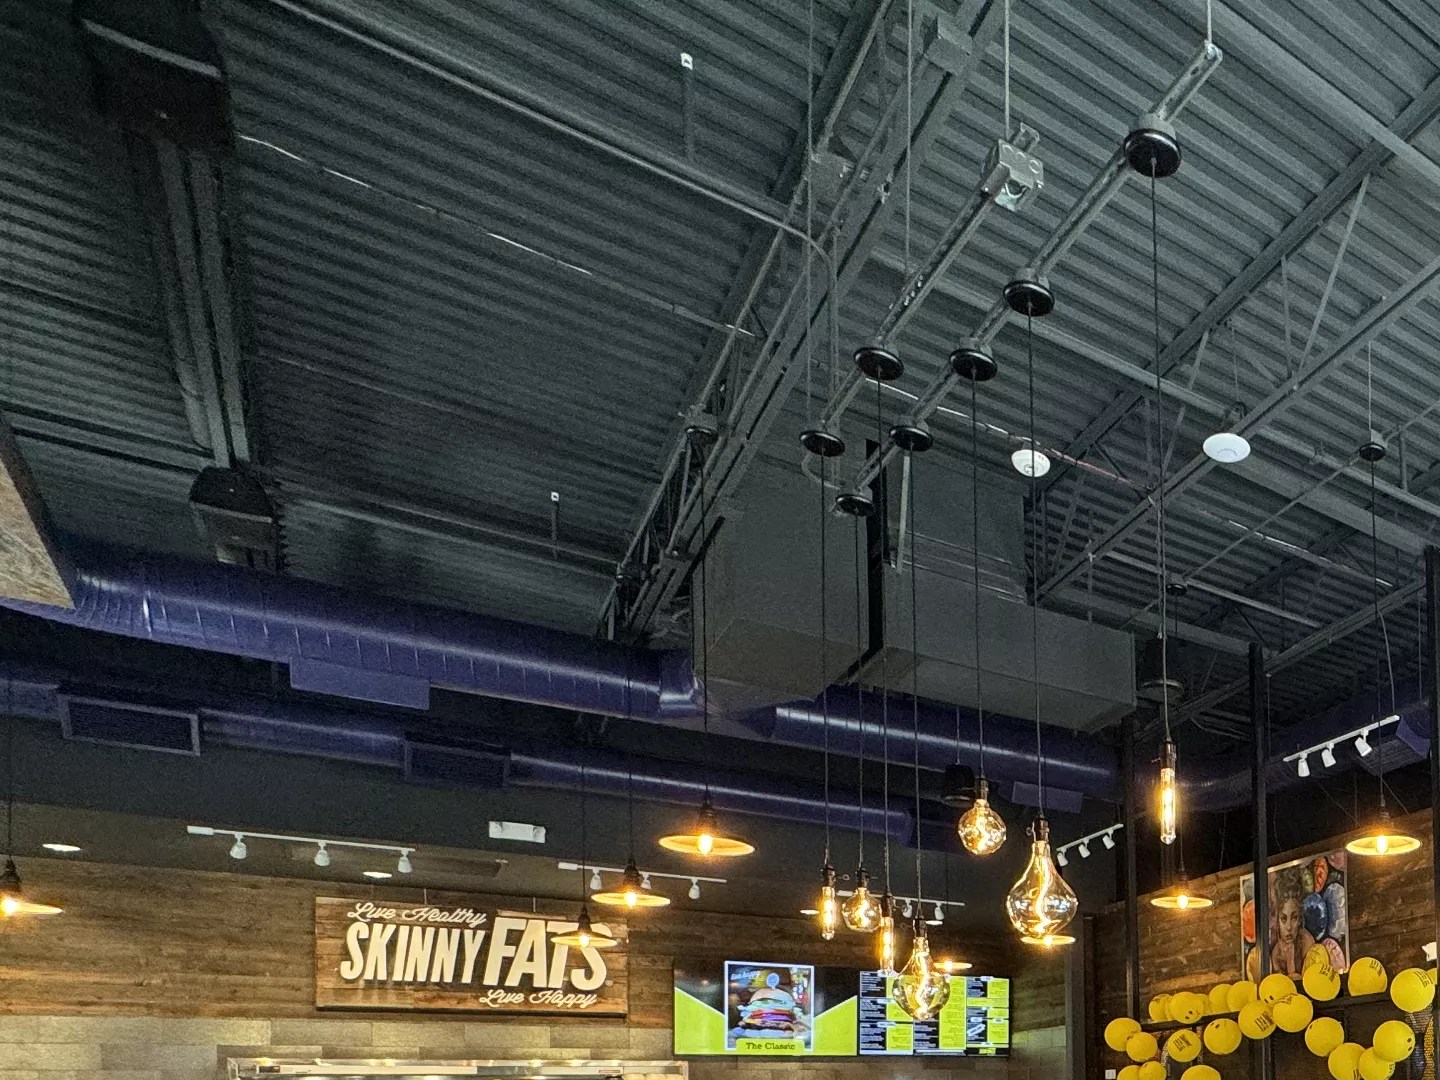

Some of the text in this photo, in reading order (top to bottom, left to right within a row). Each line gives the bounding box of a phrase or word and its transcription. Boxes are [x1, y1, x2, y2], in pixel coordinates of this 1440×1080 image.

[347, 902, 487, 928] Live Healthy
[340, 916, 612, 990] SKINNY FATS
[479, 989, 597, 1009] Live Happy
[745, 1042, 796, 1050] The Classic
